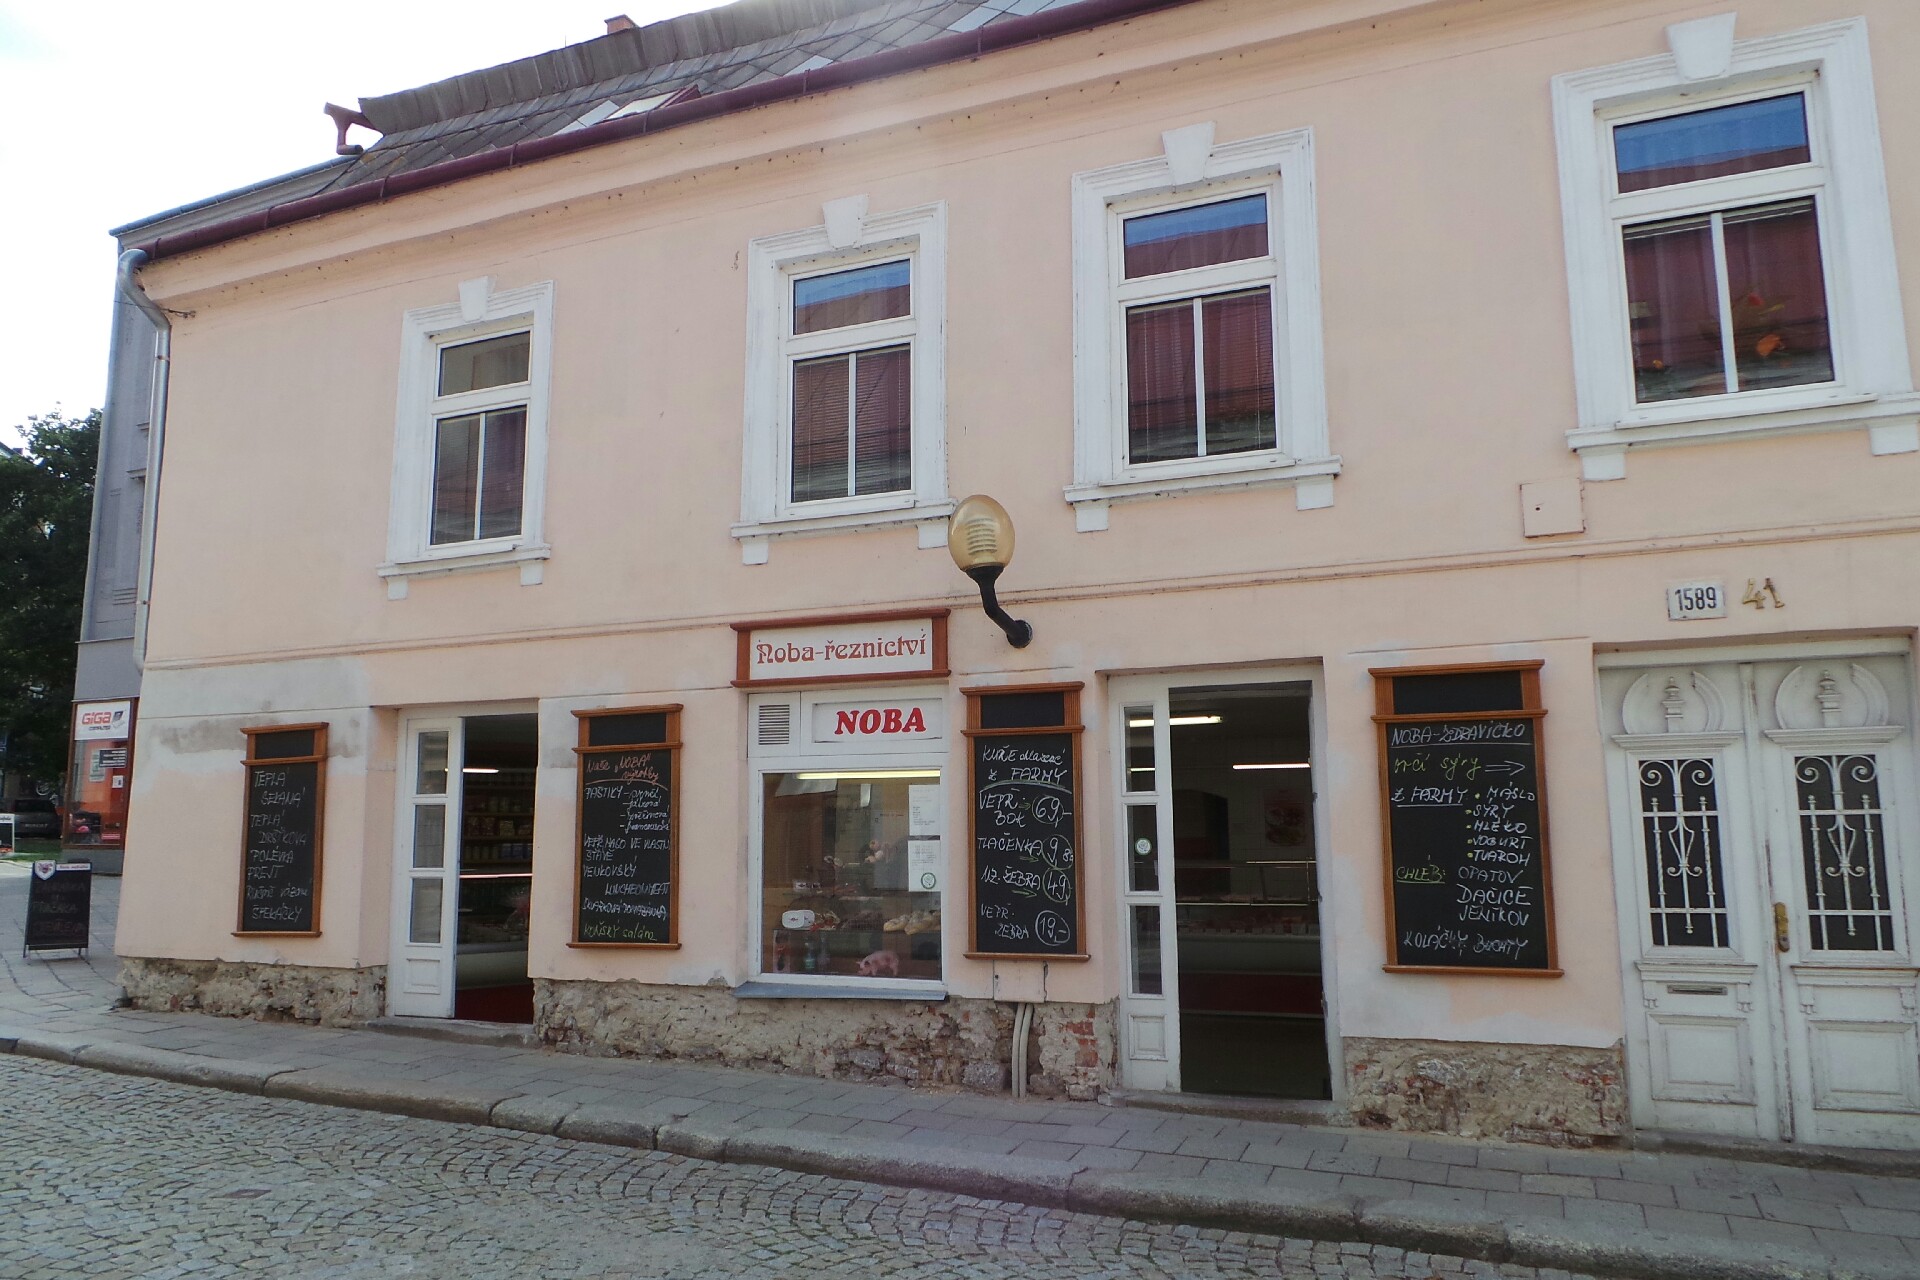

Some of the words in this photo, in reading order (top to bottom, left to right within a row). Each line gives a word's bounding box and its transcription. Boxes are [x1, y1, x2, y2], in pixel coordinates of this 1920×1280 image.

[1675, 586, 1718, 611] 1589
[756, 634, 927, 664] Noba-řeznictví
[834, 707, 927, 735] NOBA
[1011, 767, 1068, 785] FARMY
[1411, 786, 1468, 804] FARMY
[994, 810, 1027, 828] BOK
[1473, 817, 1527, 834] MLÉKO
[977, 832, 1043, 857] TLAČENKA
[1472, 849, 1531, 867] TVAROH
[1458, 866, 1524, 884] OPATOV
[1456, 883, 1534, 906] DAČICE
